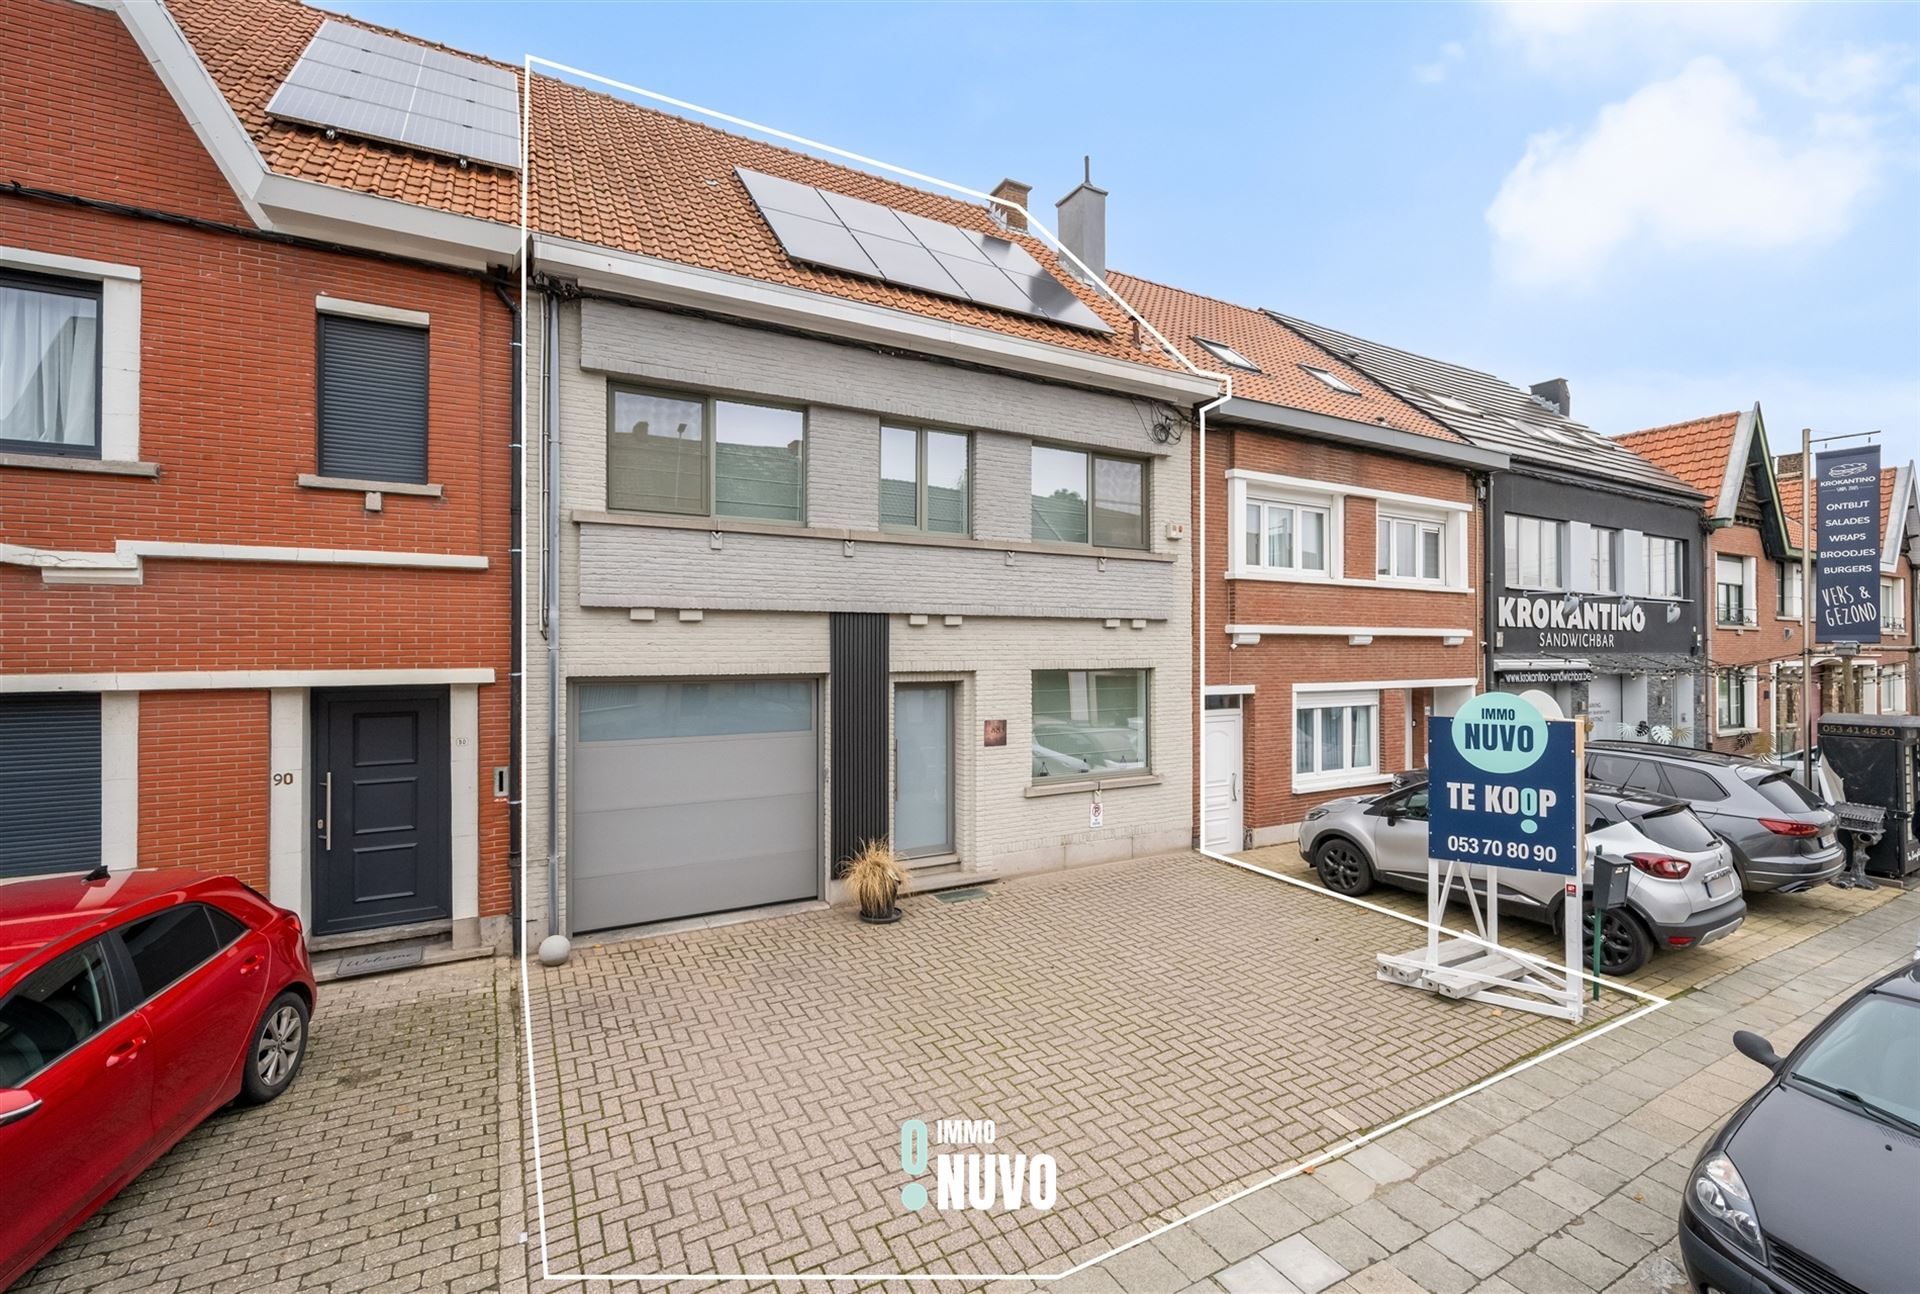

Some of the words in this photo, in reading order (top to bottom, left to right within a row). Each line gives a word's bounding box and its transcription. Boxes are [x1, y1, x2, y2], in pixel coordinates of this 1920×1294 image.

[1820, 476, 1876, 487] KROKANTINO
[1826, 500, 1870, 511] ONTBIJT
[1825, 516, 1870, 527] SALADES
[1829, 533, 1866, 542] WRAPS
[1820, 548, 1876, 558] BROODJES
[1823, 565, 1872, 574] BURGERS
[1822, 586, 1854, 607] VERS
[1859, 586, 1871, 599] &
[1498, 597, 1646, 632] KROKANTINO
[1825, 602, 1877, 627] GEZOND
[1539, 632, 1615, 648] SANDWICHBAR
[1481, 708, 1515, 720] IMMO
[1822, 724, 1843, 733] 053
[1846, 725, 1860, 734] 41
[1863, 726, 1878, 736] 46
[1880, 727, 1896, 736] 50
[1465, 723, 1534, 753] NUVO
[273, 772, 294, 786] 90
[1446, 782, 1475, 811] TE
[1485, 785, 1557, 818] KOOP
[1448, 835, 1479, 854] 053
[1482, 839, 1503, 857] 70
[1507, 842, 1529, 860] 80
[1533, 845, 1557, 863] 90
